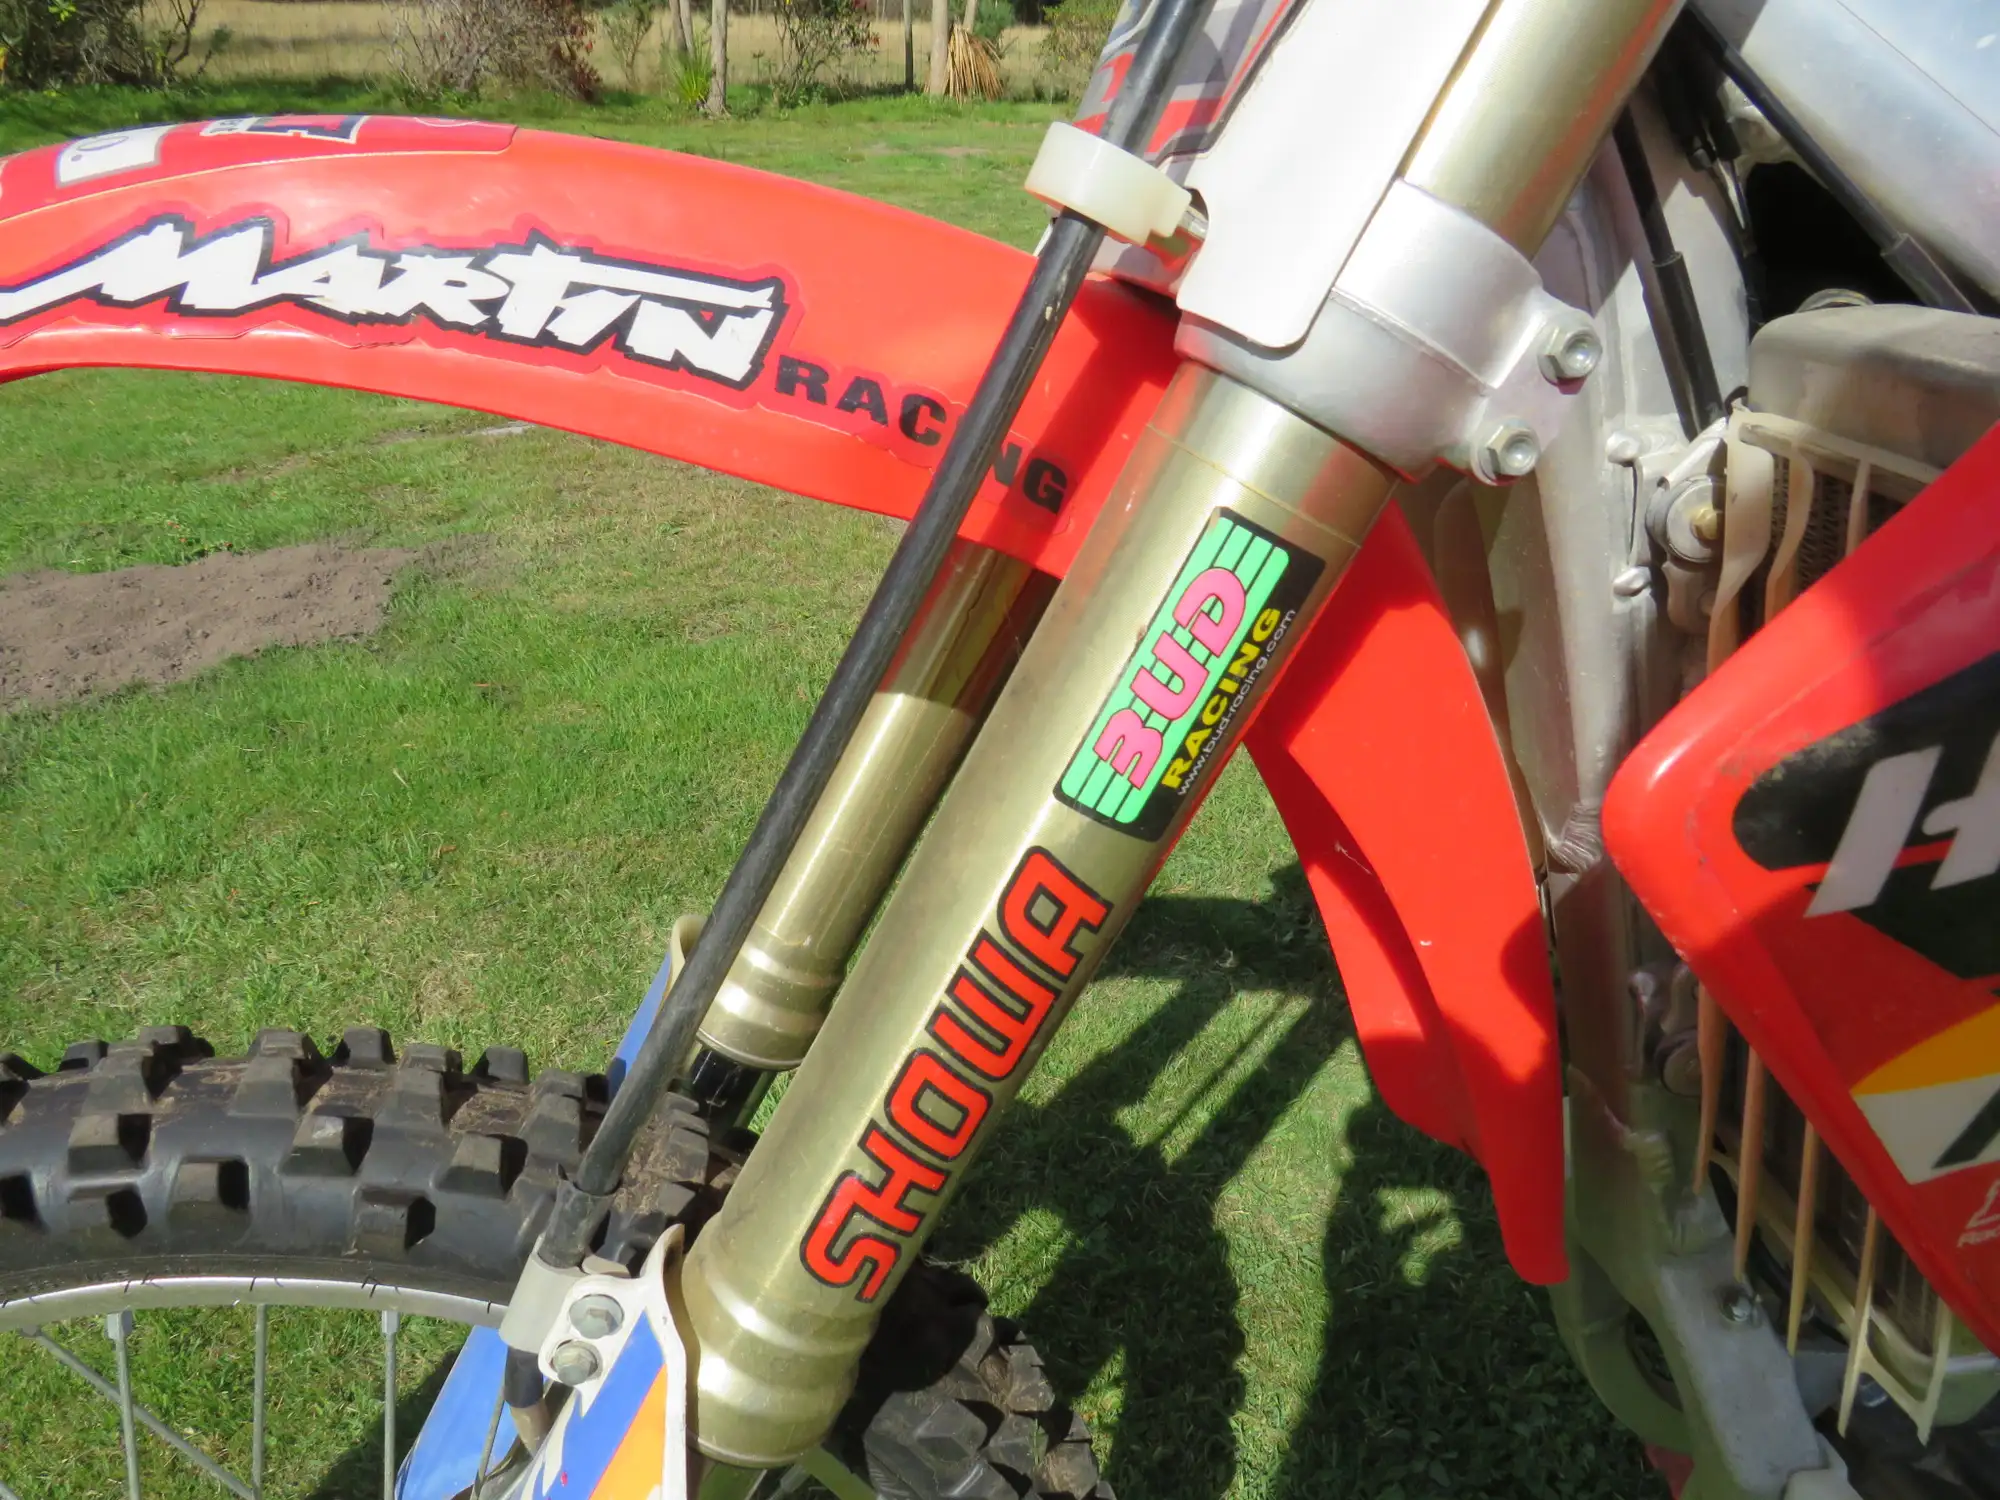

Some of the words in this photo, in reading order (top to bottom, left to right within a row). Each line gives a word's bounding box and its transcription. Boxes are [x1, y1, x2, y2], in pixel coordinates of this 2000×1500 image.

[0, 212, 785, 390] MARTIN
[775, 355, 1068, 515] RACNG
[1093, 567, 1246, 789] BUD
[1161, 607, 1281, 789] RACING
[1177, 609, 1296, 796] www.bud-racing.com
[800, 845, 1114, 1303] SHOWA
